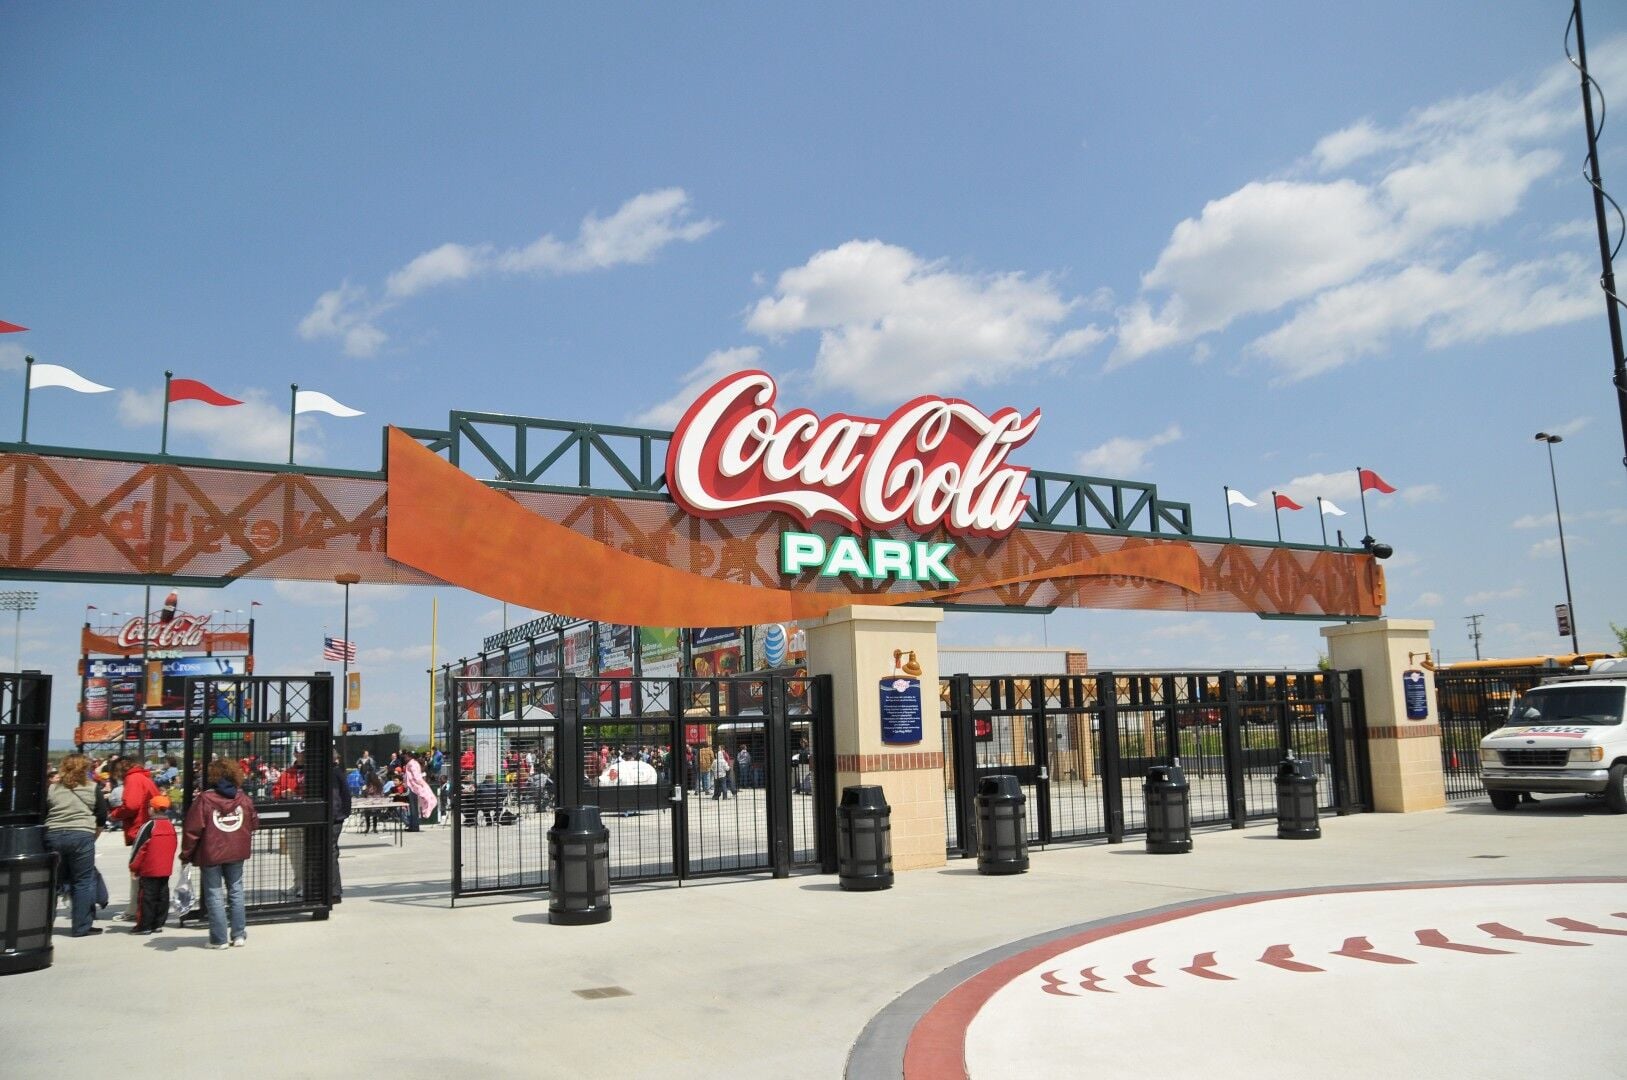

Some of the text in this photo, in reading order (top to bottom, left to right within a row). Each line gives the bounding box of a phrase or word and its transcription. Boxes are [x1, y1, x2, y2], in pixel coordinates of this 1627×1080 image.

[675, 374, 1042, 531] Coca-Cola
[781, 531, 959, 582] PARK
[108, 661, 201, 674] Capita eCross
[1526, 726, 1590, 734] NEWS
